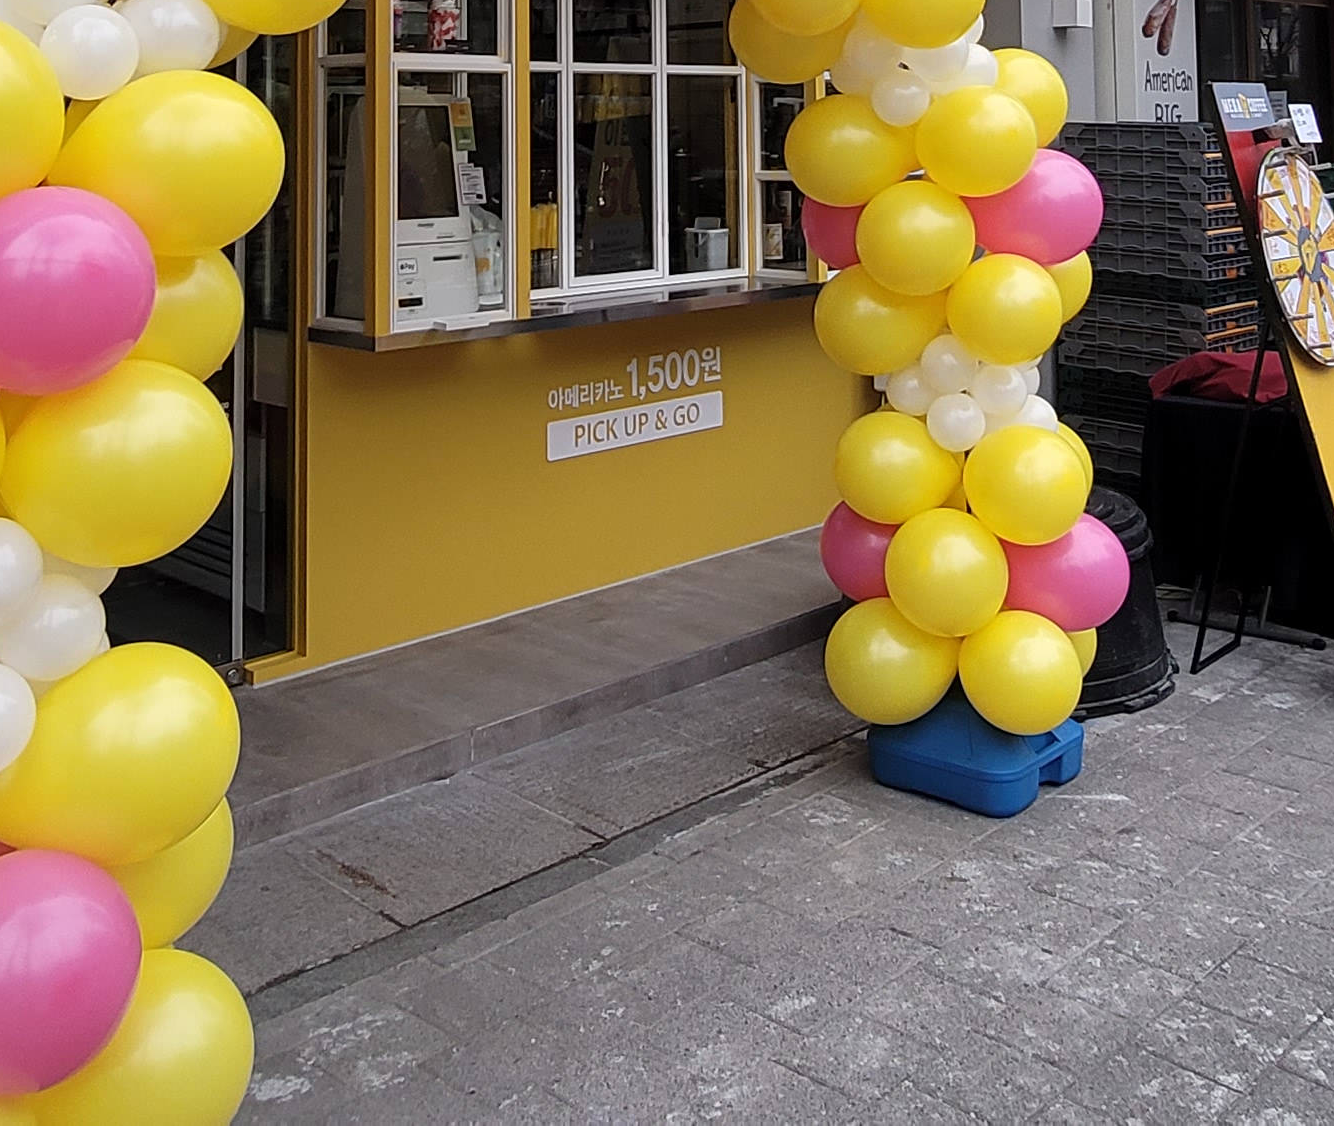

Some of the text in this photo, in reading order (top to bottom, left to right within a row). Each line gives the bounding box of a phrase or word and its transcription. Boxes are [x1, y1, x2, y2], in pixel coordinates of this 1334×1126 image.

[1144, 60, 1193, 93] American
[548, 346, 723, 411] 아메리카노 1,500원
[574, 402, 701, 449] PICK UP & GO
